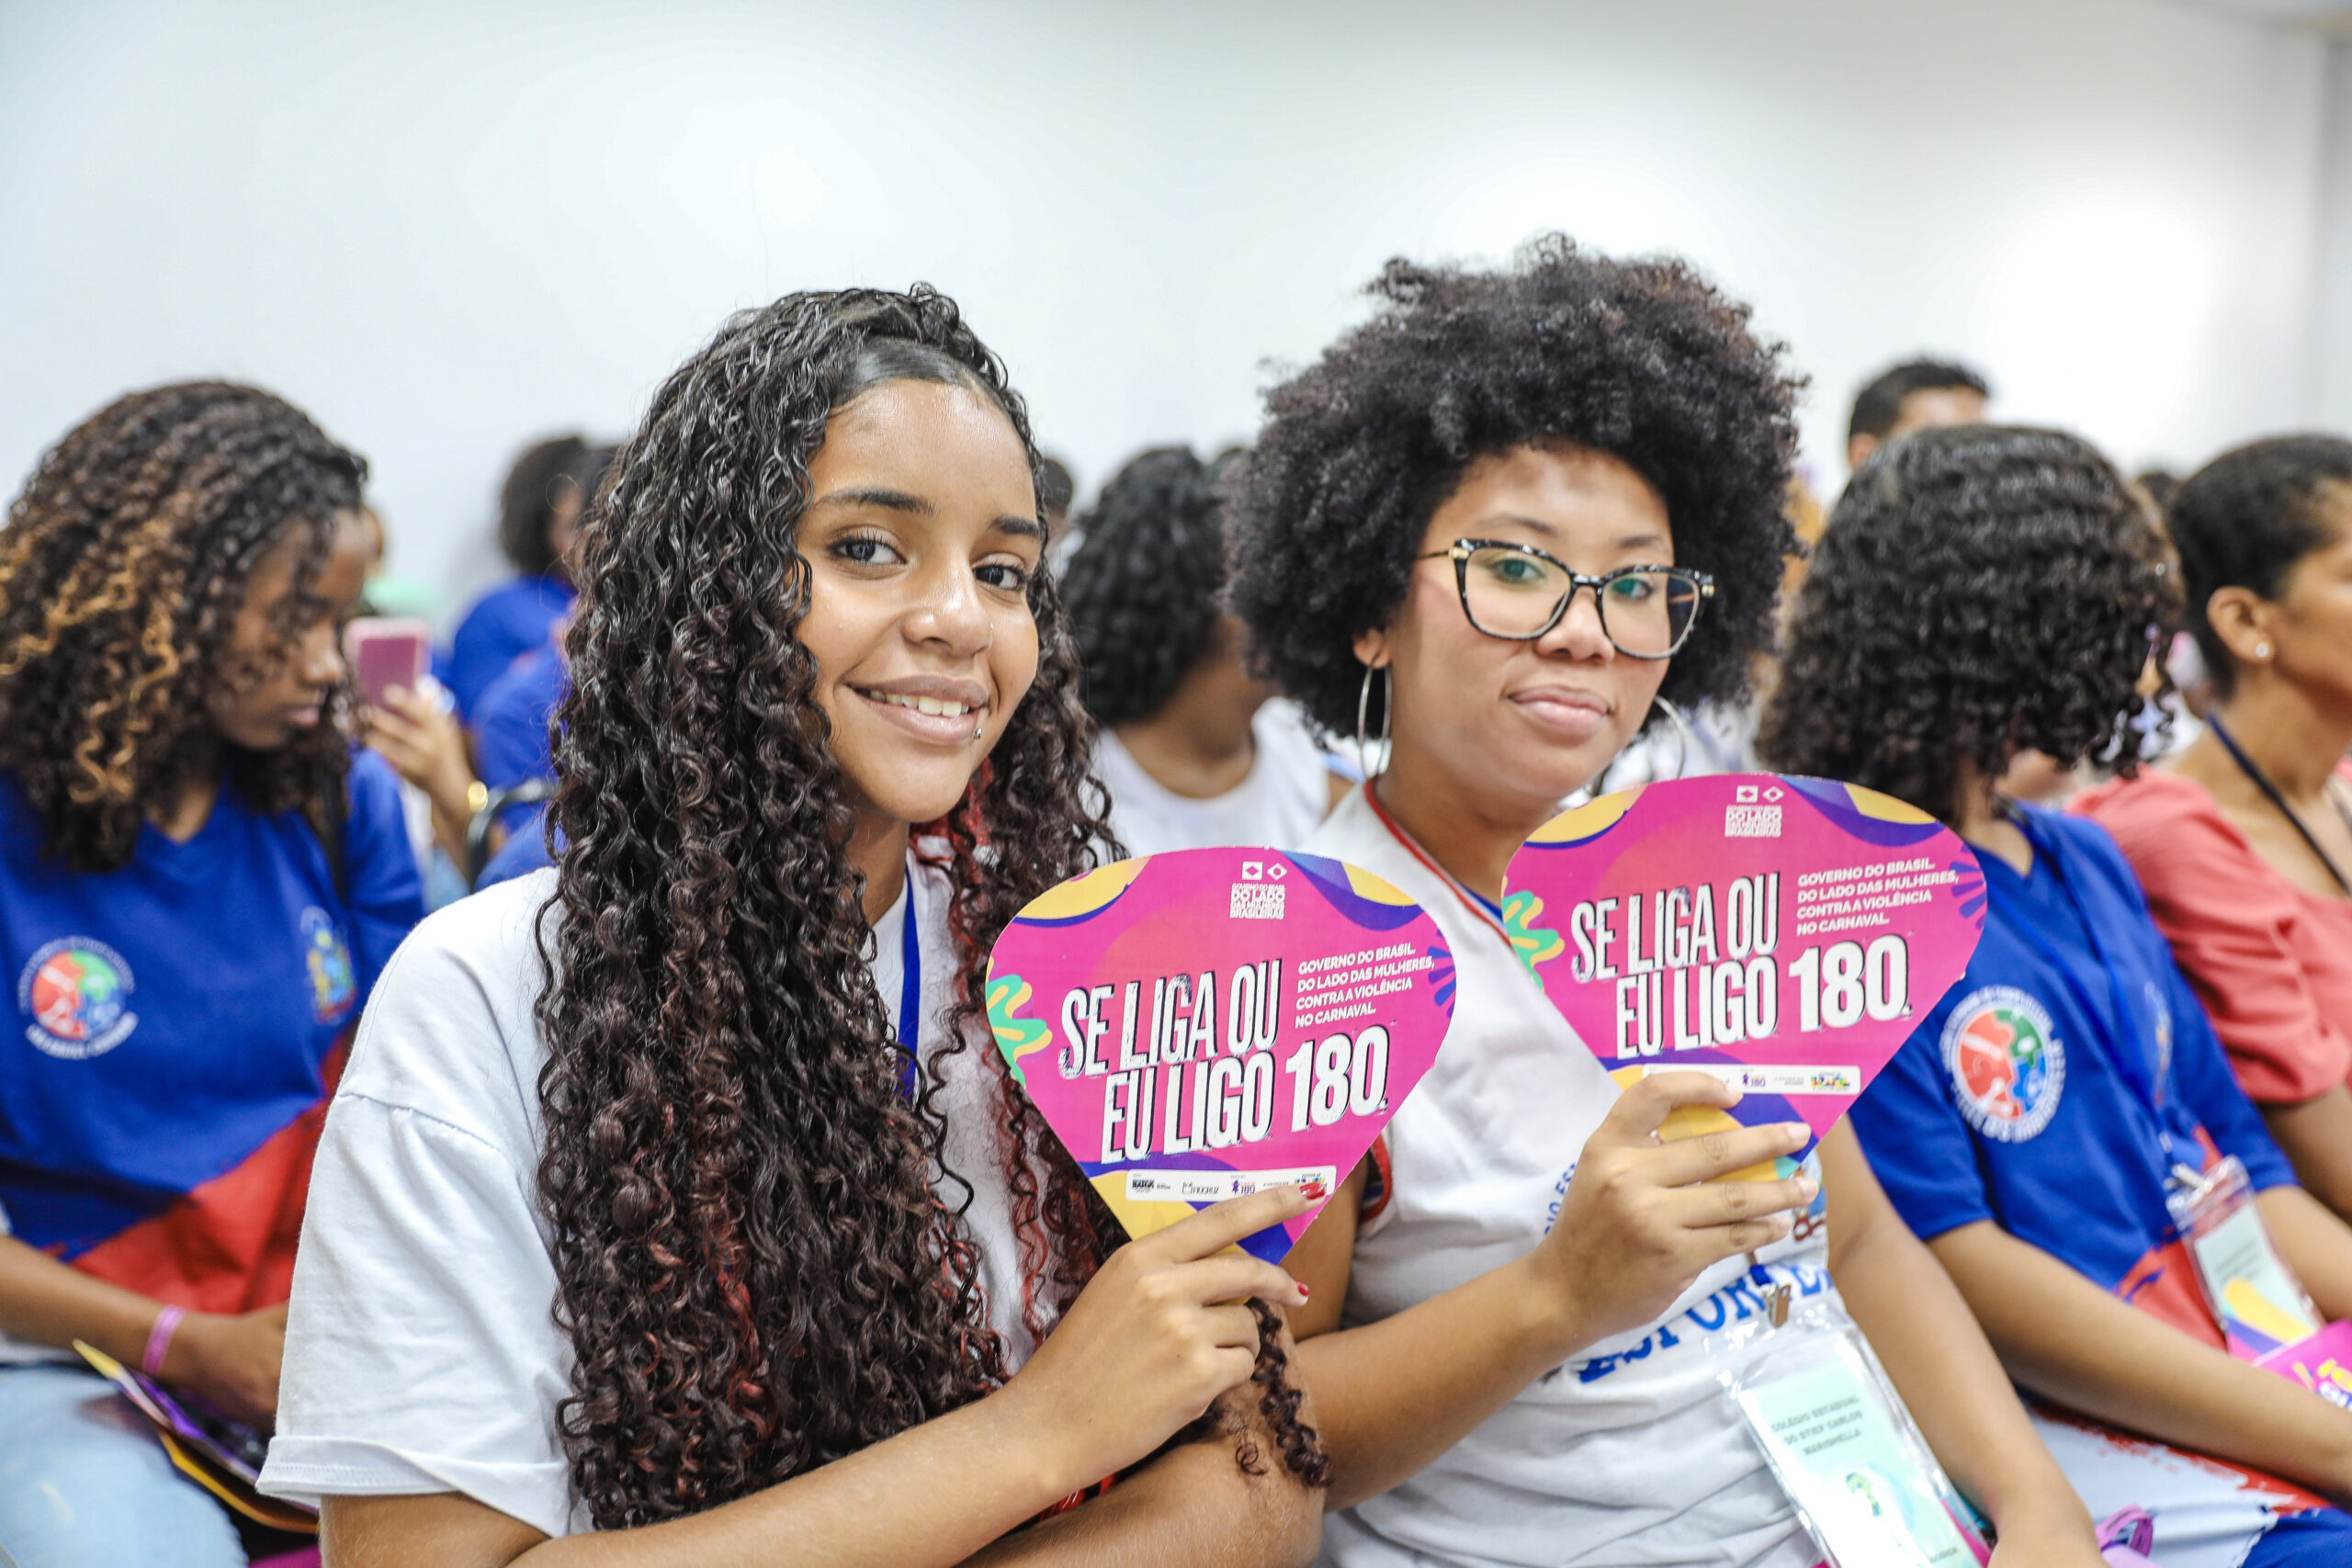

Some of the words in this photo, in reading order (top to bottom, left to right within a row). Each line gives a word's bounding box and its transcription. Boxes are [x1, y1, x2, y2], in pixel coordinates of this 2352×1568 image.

[1725, 810, 1747, 821] DO
[1747, 810, 1782, 822] LADO
[1797, 890, 1817, 904] DO
[1819, 885, 1855, 900] LADO
[1857, 881, 1883, 896] DAS
[1885, 870, 1960, 891] MULHERES,
[1798, 867, 1862, 887] GOVERNO
[1864, 863, 1884, 878] DO
[1886, 857, 1936, 876] BRASIL.
[1231, 889, 1250, 901] DO
[1251, 890, 1285, 903] LADO
[1796, 899, 1851, 919] CONTRA
[1852, 899, 1862, 912] A
[1863, 889, 1932, 909] VIOLÊNCIA
[1570, 897, 1619, 984] SE
[1627, 883, 1720, 975] LIGA
[1727, 872, 1780, 962] OU
[1796, 921, 1817, 936] NO
[1819, 911, 1891, 933] CARNAVAL.
[1297, 977, 1315, 993] DO
[1317, 971, 1349, 989] LADO
[1351, 966, 1373, 983] DAS
[1374, 955, 1434, 978] MULHERES,
[1298, 953, 1355, 975] GOVERNO
[1357, 950, 1374, 964] DO
[1375, 942, 1416, 961] BRASIL.
[1295, 989, 1344, 1010] CONTRA
[1345, 988, 1353, 1001] A
[1354, 977, 1412, 999] VIOLÊNCIA
[1616, 971, 1663, 1060] EU
[1674, 955, 1779, 1052] LIGO
[1057, 984, 1114, 1079] SE
[1120, 971, 1218, 1071] LIGA
[1227, 958, 1283, 1055] OU
[1295, 1013, 1314, 1029] NO
[1315, 1002, 1376, 1024] CARNAVAL.
[1101, 1067, 1156, 1164] EU
[1163, 1051, 1275, 1155] LIGO
